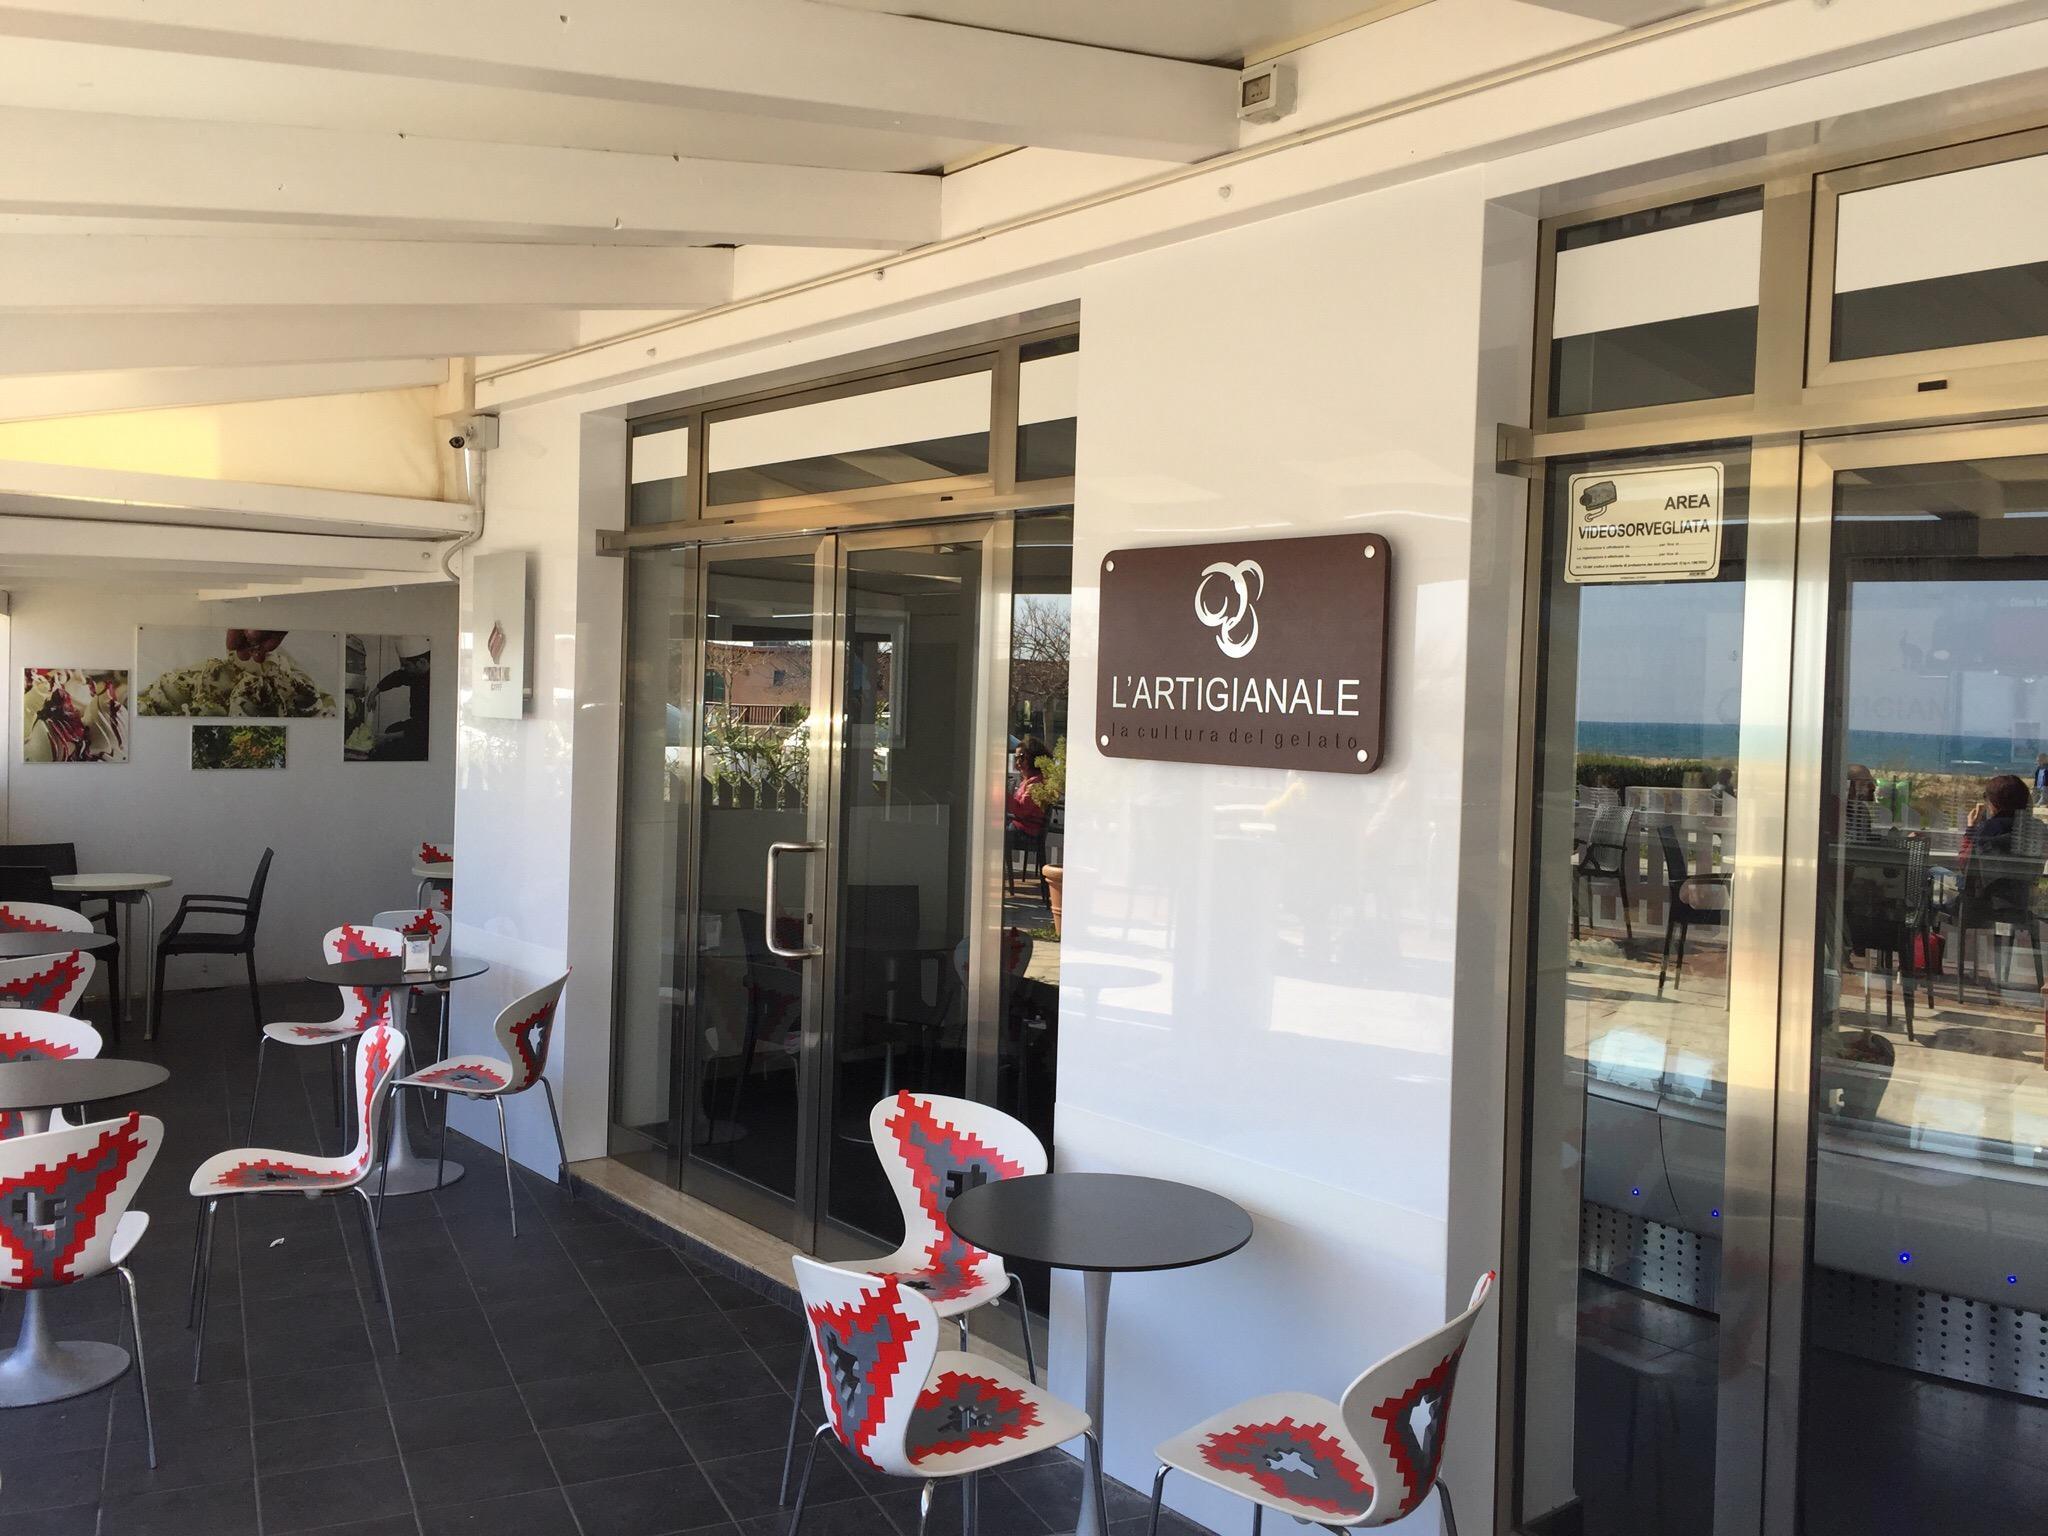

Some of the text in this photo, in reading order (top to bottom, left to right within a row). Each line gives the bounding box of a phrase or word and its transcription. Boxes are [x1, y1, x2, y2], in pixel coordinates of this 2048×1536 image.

[1664, 494, 1711, 510] AREA
[1578, 519, 1710, 540] VIDEOSORVEGLIATA
[1111, 675, 1360, 716] L'ARTIGIANALE
[1111, 722, 1358, 749] la cultura del gelato
